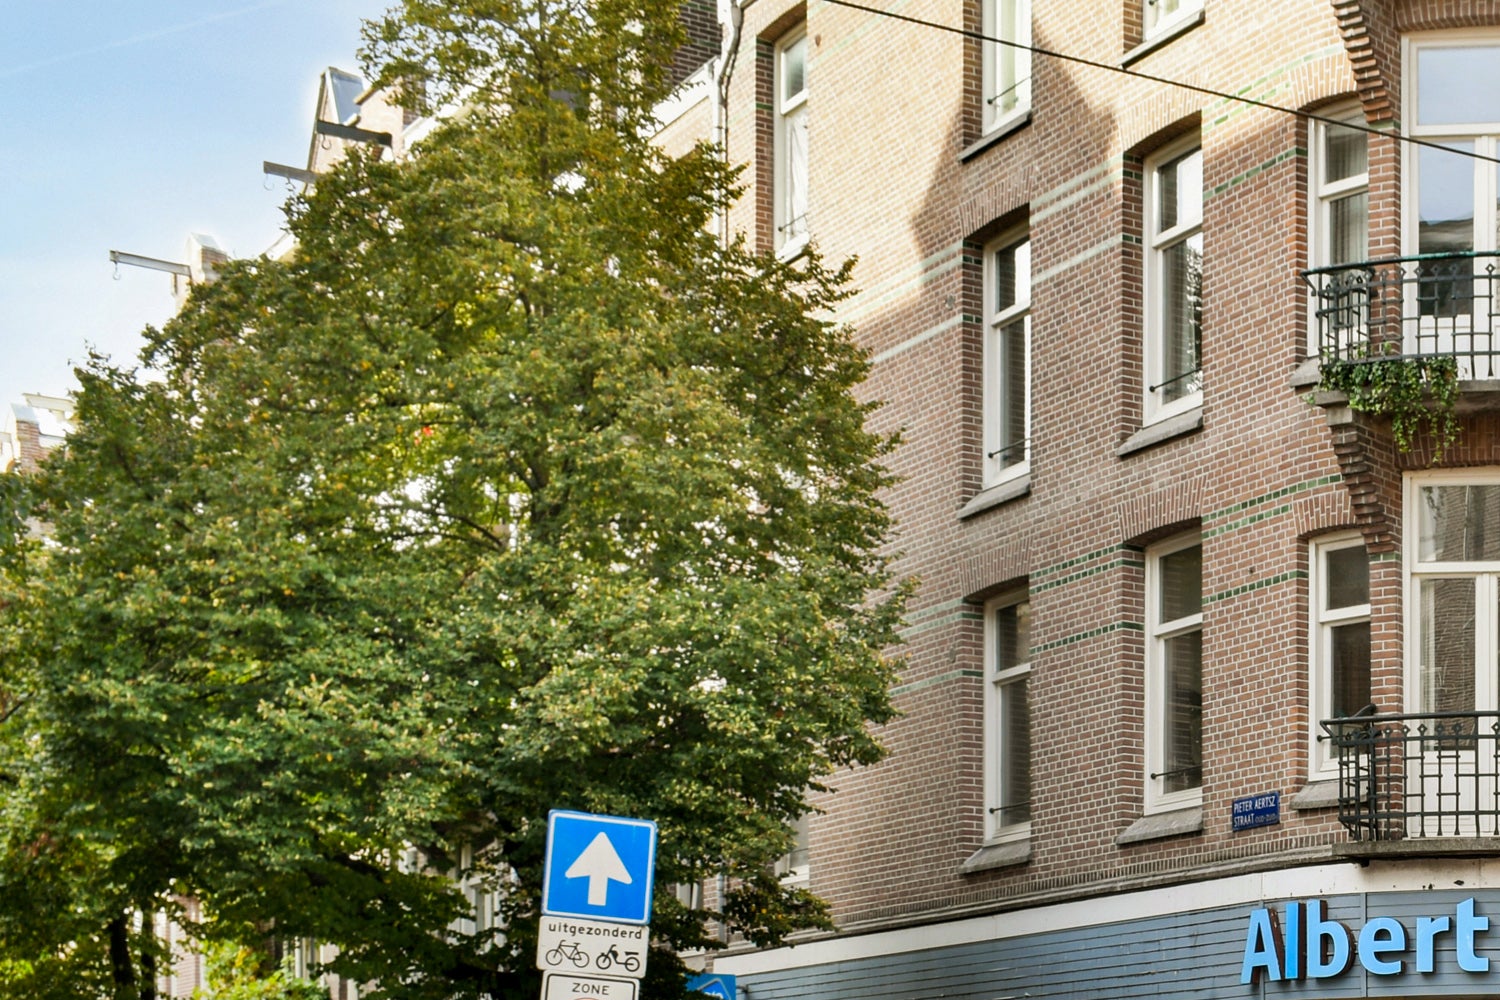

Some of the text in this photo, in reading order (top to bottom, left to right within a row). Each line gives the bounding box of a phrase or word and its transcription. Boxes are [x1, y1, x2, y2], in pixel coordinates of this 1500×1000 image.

[1234, 800, 1253, 814] PIETER
[1234, 813, 1255, 827] STRAAT
[549, 922, 642, 940] uitgezonderd
[1240, 897, 1489, 985] Albert
[572, 983, 610, 996] ZONE
